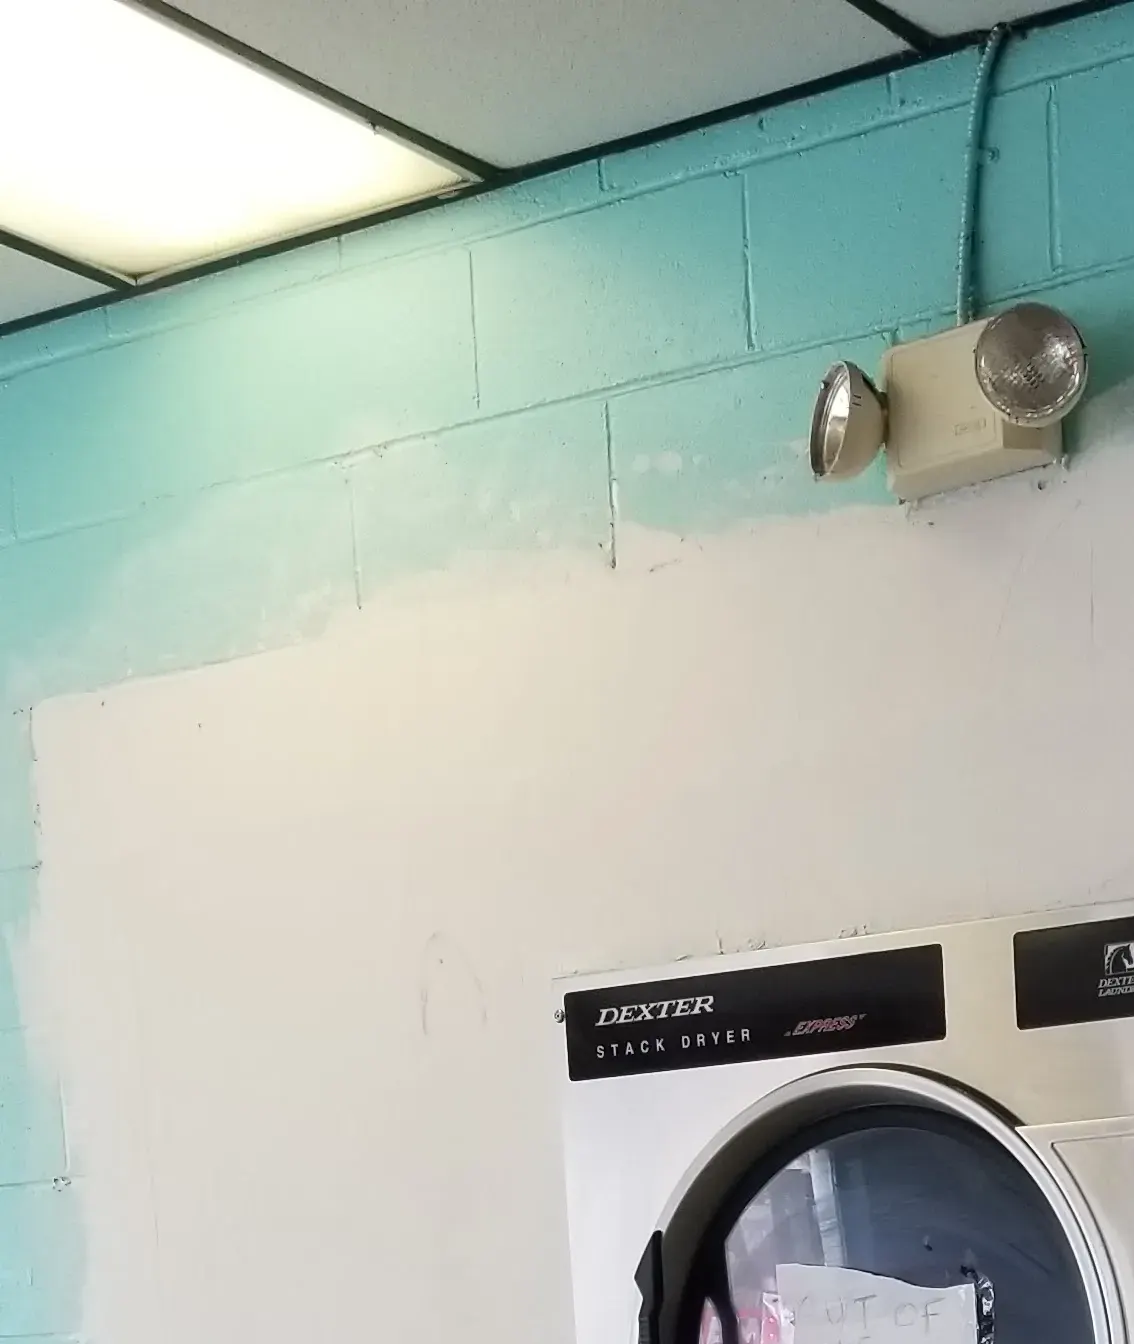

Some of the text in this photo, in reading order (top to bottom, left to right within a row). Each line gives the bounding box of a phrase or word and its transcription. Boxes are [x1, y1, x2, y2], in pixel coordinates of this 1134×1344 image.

[595, 995, 715, 1027] DEXTER
[792, 1014, 859, 1036] EXPRESS
[596, 1028, 751, 1059] STACK DRYER
[893, 1297, 947, 1336] OF
